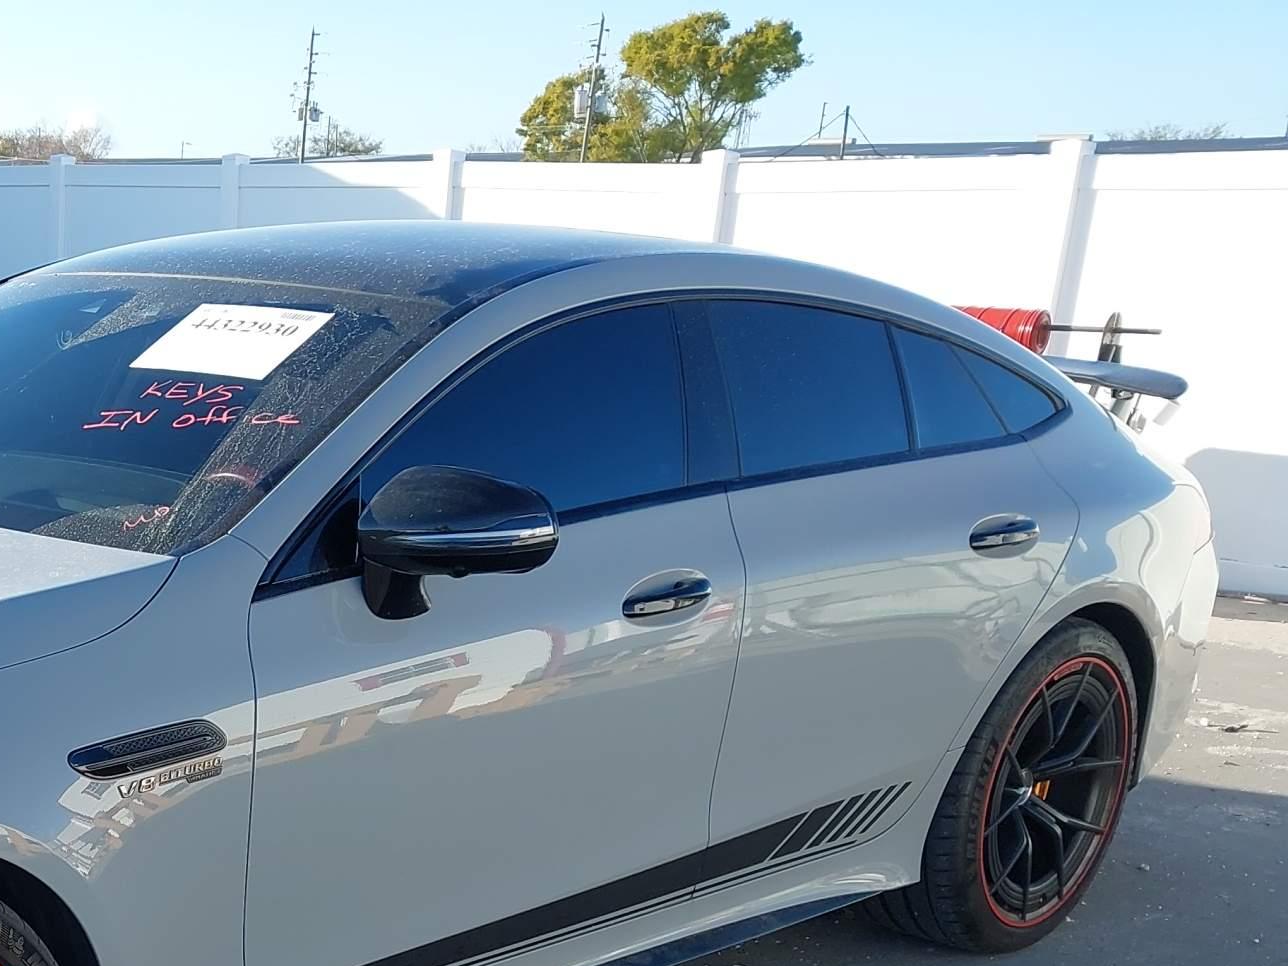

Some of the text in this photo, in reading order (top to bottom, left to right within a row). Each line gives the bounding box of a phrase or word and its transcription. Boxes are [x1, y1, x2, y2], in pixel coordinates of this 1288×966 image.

[191, 317, 300, 337] 44322930
[140, 380, 244, 406] KEYS
[82, 408, 159, 431] IN
[117, 775, 158, 798] V8
